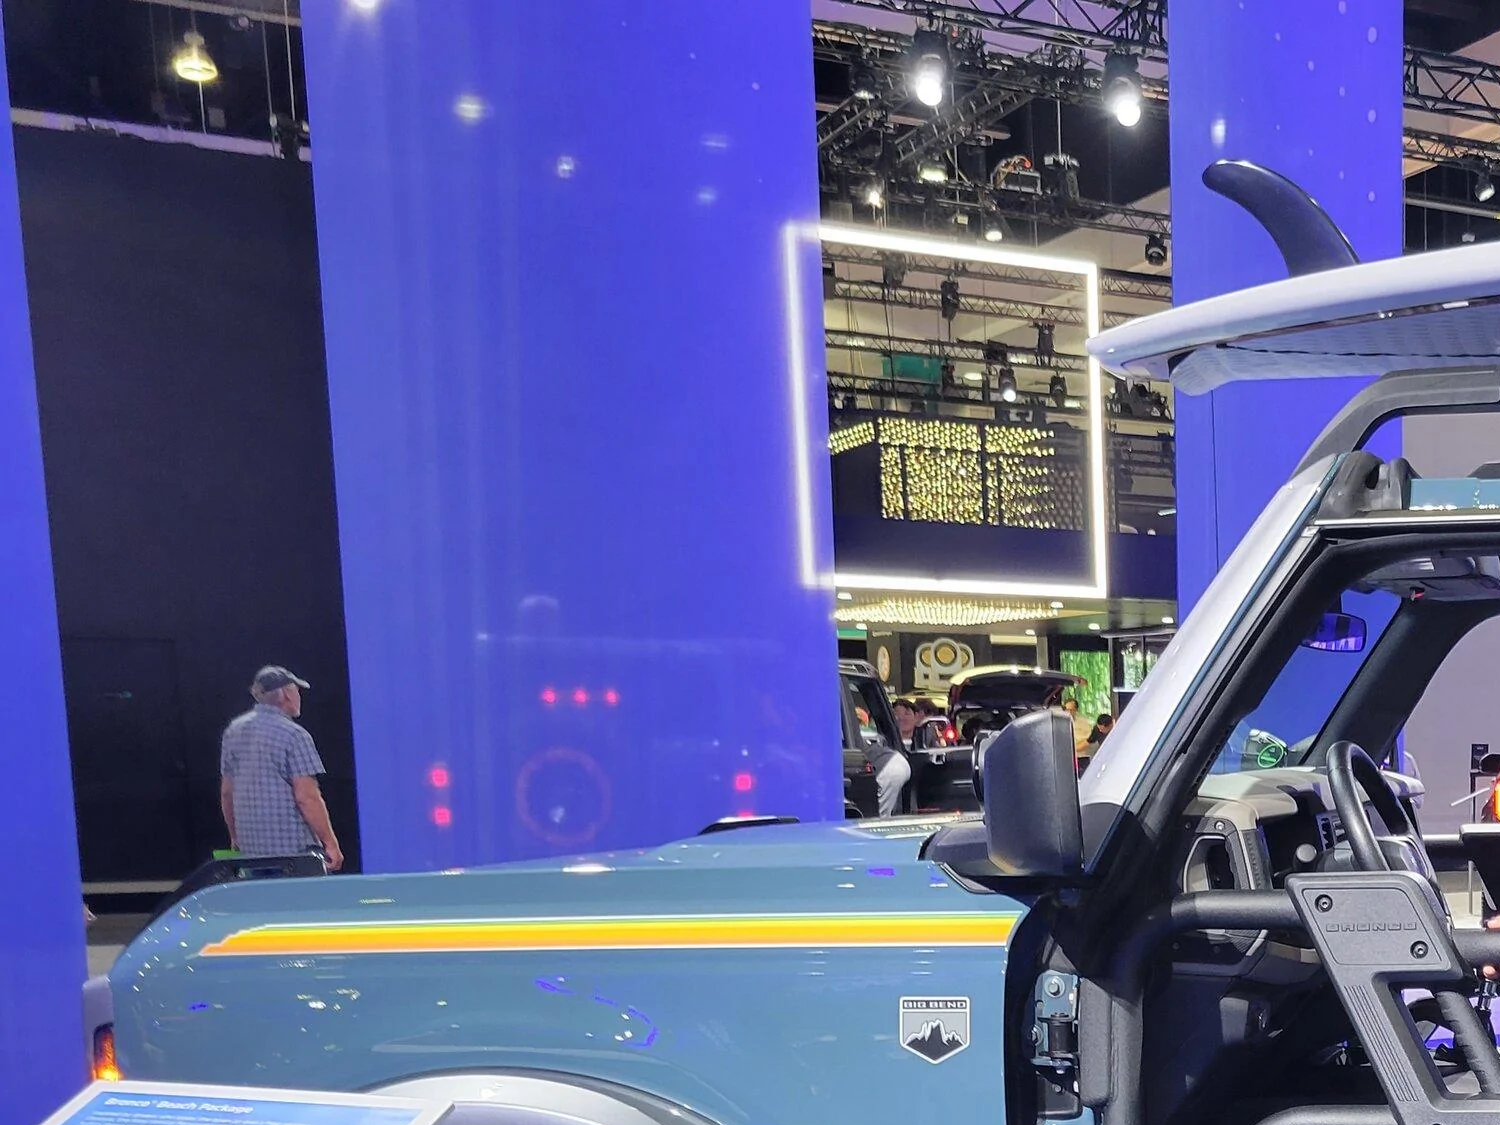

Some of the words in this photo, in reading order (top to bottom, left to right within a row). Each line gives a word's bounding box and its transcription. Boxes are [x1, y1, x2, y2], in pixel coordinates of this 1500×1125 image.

[1325, 922, 1417, 932] BRONCO
[156, 1100, 197, 1111] Beach
[198, 1102, 254, 1114] Package
